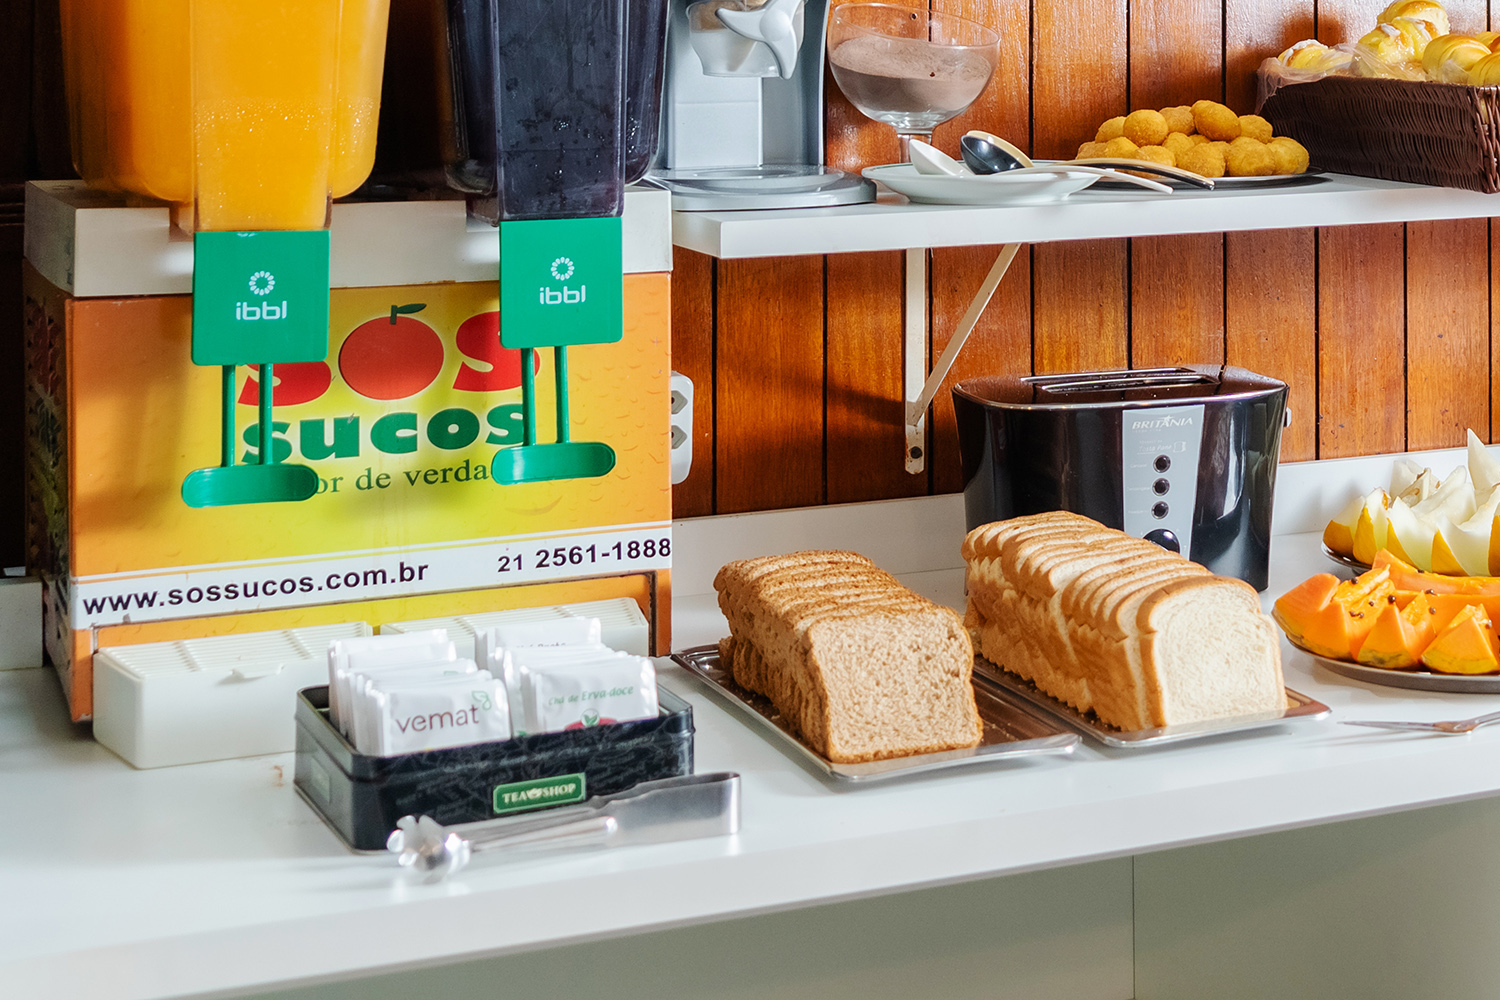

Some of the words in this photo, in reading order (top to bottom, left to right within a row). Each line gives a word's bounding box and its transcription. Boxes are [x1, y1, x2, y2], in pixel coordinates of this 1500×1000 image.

[540, 285, 586, 304] ibbl
[236, 301, 287, 320] ibbl
[355, 467, 391, 490] de
[403, 459, 490, 486] verda
[498, 554, 523, 572] 21
[535, 538, 671, 569] 2561-1888
[83, 561, 429, 615] www.sossucos.com.br
[568, 693, 579, 704] de
[396, 704, 479, 734] vemat
[502, 790, 528, 805] TEA
[543, 783, 576, 798] SHOP
